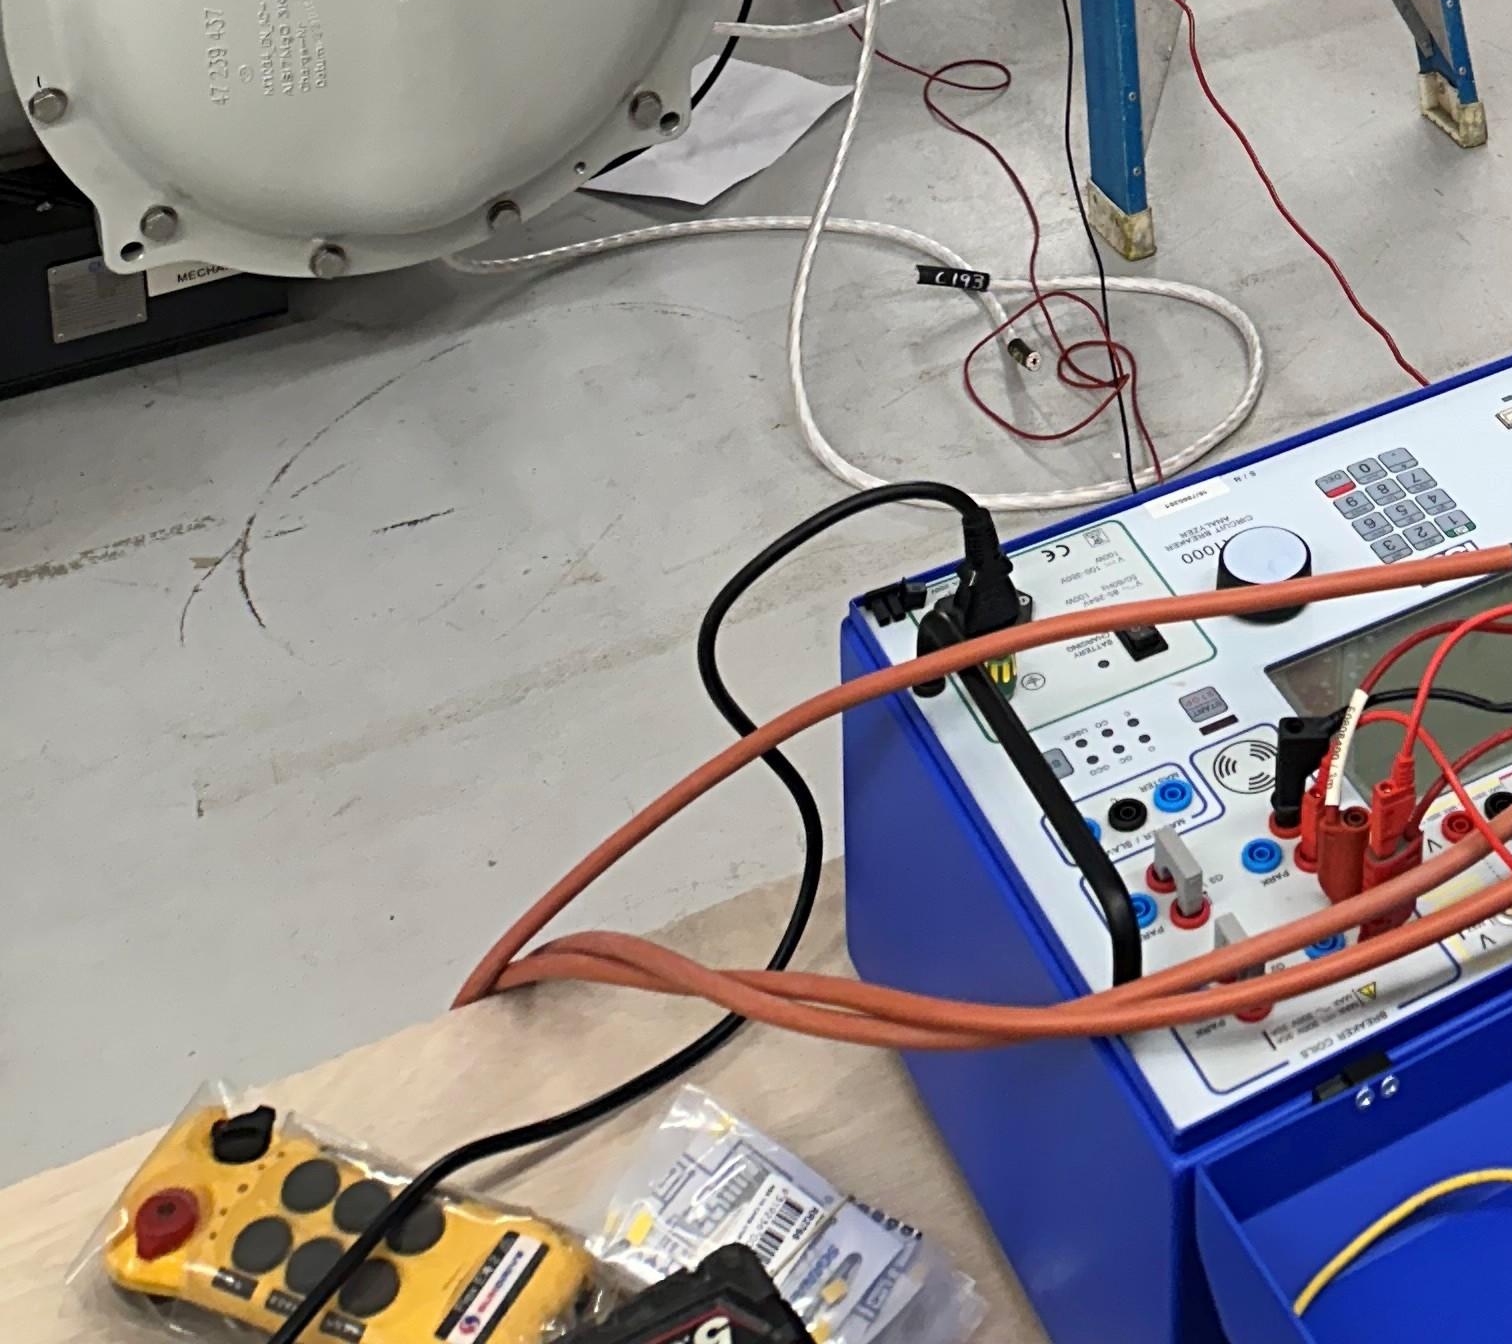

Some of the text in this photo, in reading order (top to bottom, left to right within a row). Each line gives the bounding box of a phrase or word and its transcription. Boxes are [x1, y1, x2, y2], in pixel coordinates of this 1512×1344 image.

[203, 8, 226, 41] 437
[208, 47, 229, 81] 239
[208, 84, 230, 105] 47
[1163, 530, 1212, 552] BREAKER
[1259, 870, 1291, 888] PARK
[1336, 1012, 1388, 1041] BREAKER
[1299, 1037, 1335, 1059] COILS
